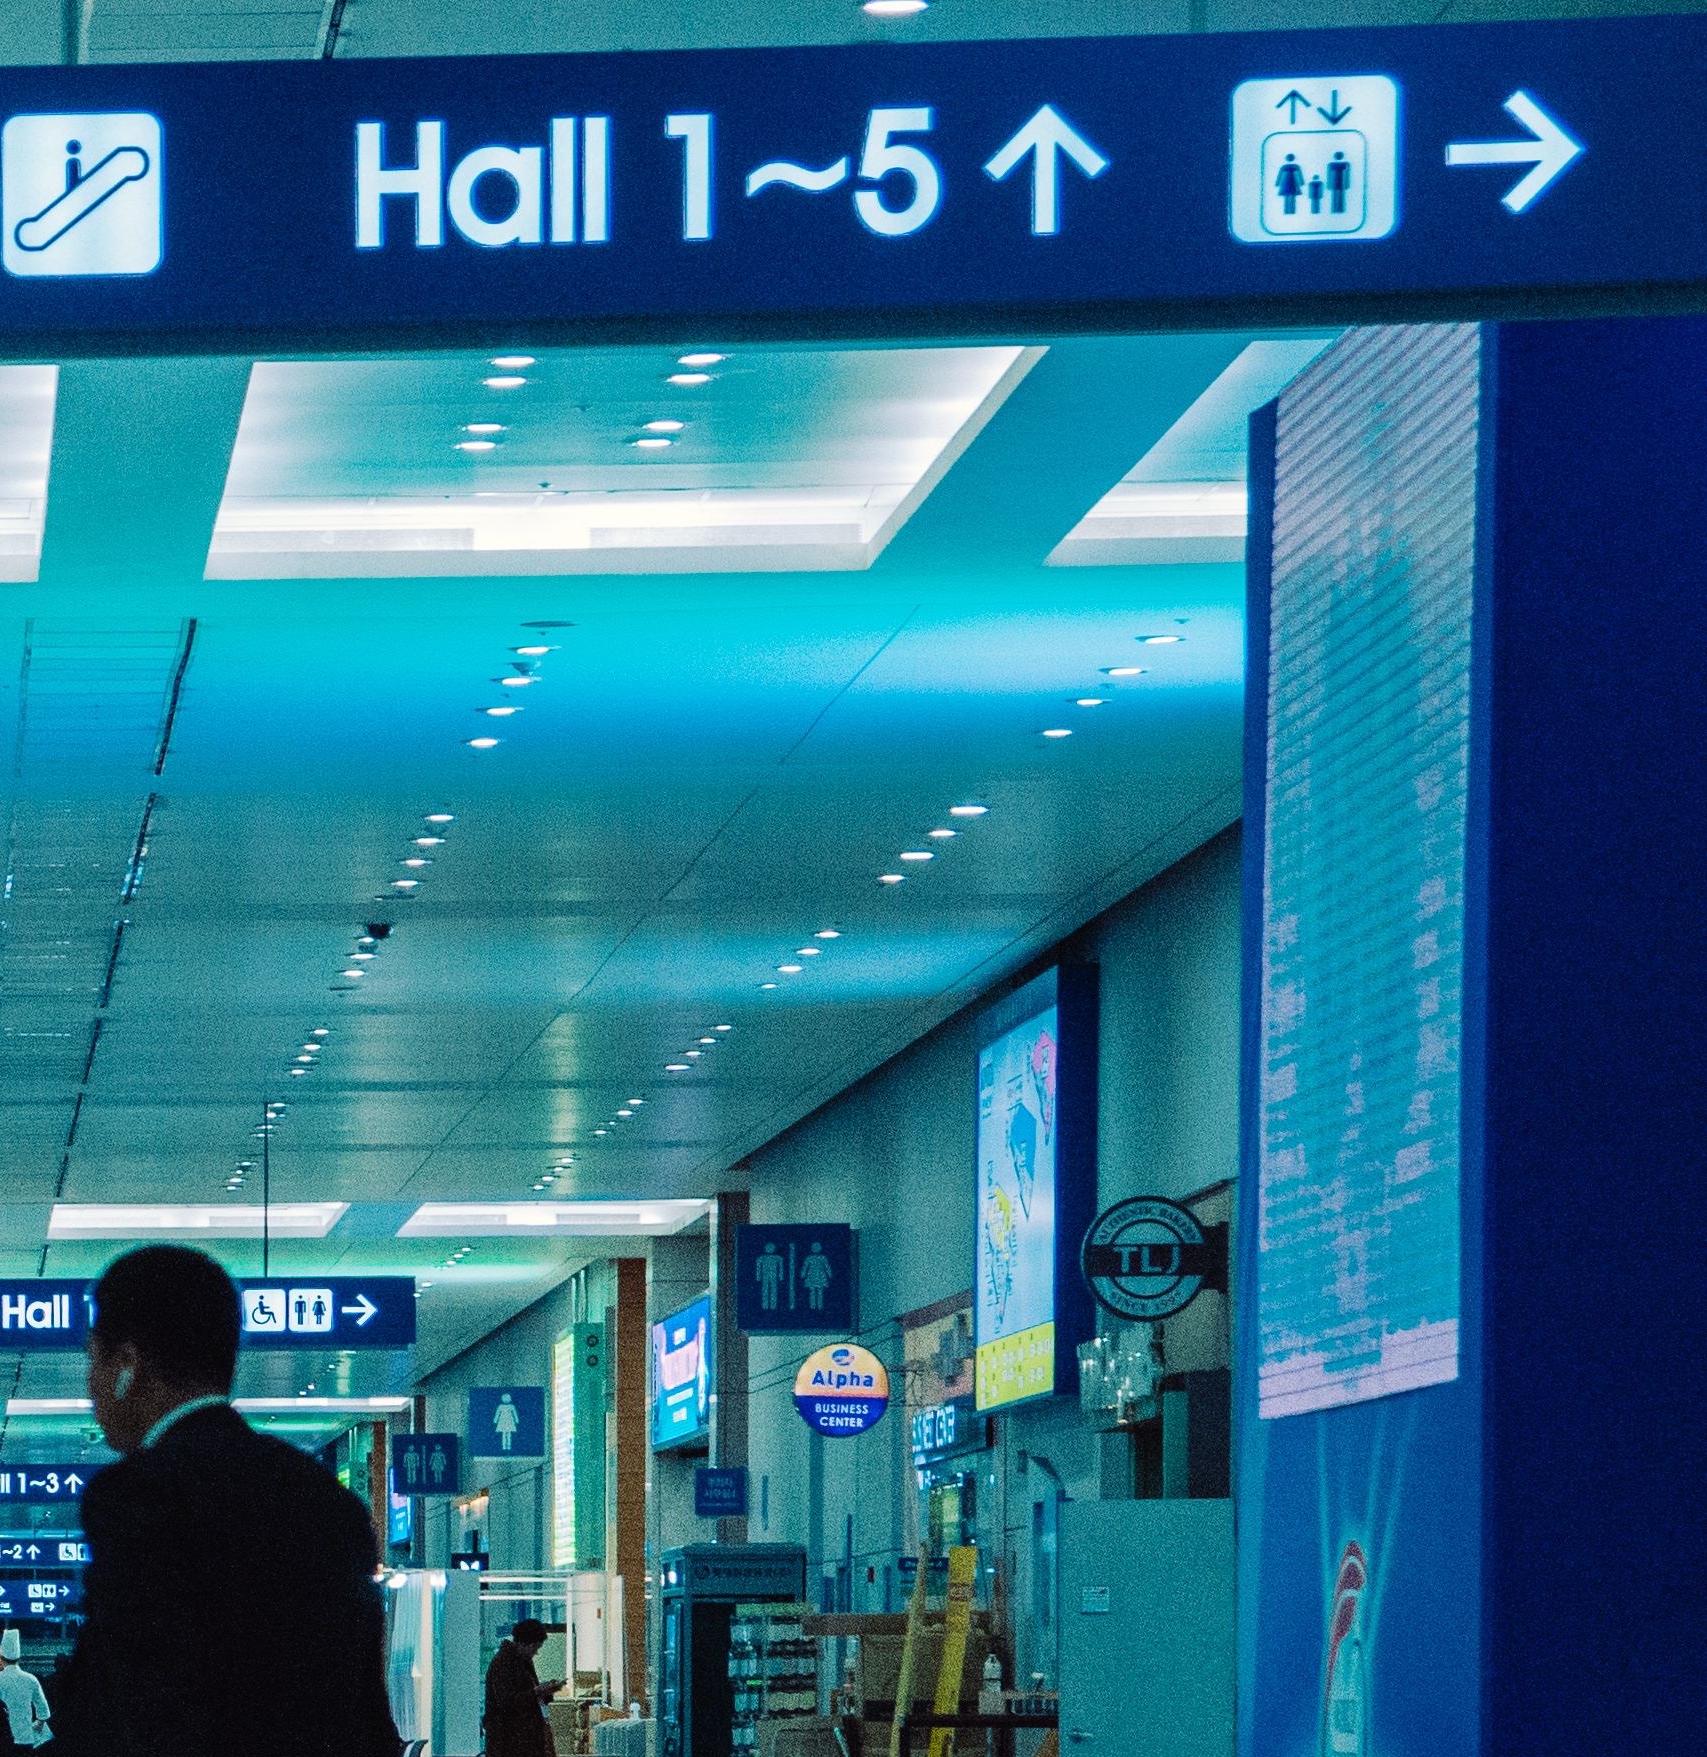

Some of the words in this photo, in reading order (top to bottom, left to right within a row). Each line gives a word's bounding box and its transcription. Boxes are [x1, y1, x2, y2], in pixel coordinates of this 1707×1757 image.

[354, 115, 612, 249] Hall
[665, 106, 942, 244] 1~5
[1113, 1245, 1181, 1274] TLJ
[1, 1294, 70, 1329] Hall
[811, 1370, 874, 1390] Alpha
[814, 1403, 869, 1415] BUSINESS
[818, 1416, 864, 1428] CENTER
[17, 1472, 60, 1494] 1~3
